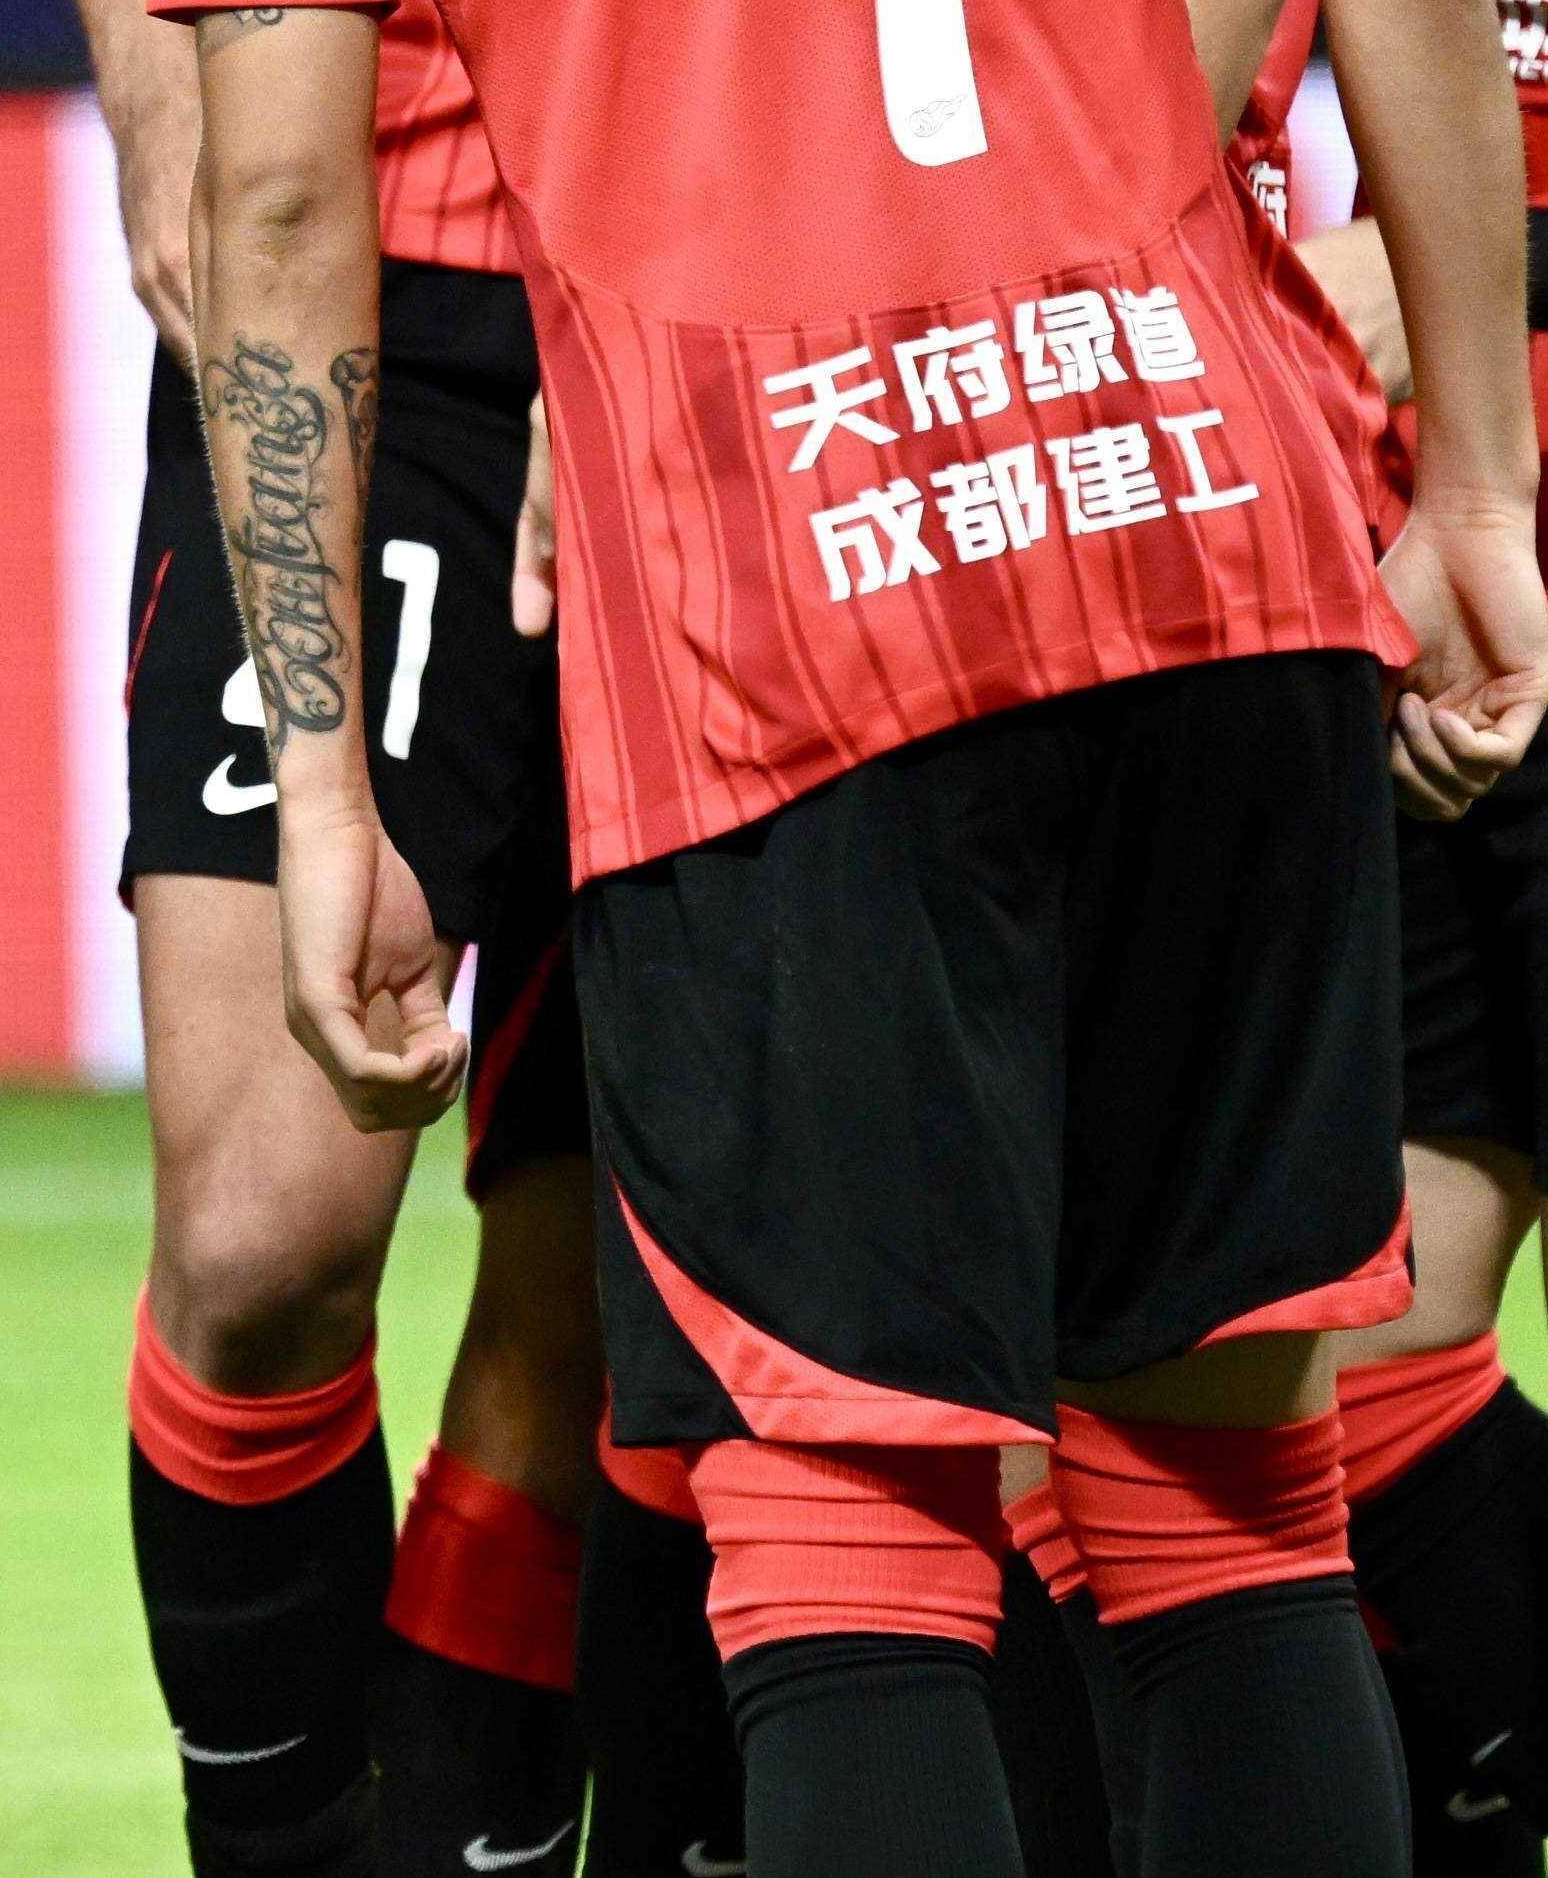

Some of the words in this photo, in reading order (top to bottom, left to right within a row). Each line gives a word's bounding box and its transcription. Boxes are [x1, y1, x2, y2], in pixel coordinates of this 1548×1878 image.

[763, 285, 1206, 473] 天府绿道
[808, 407, 1261, 603] 成都建工
[222, 539, 440, 759] 1
